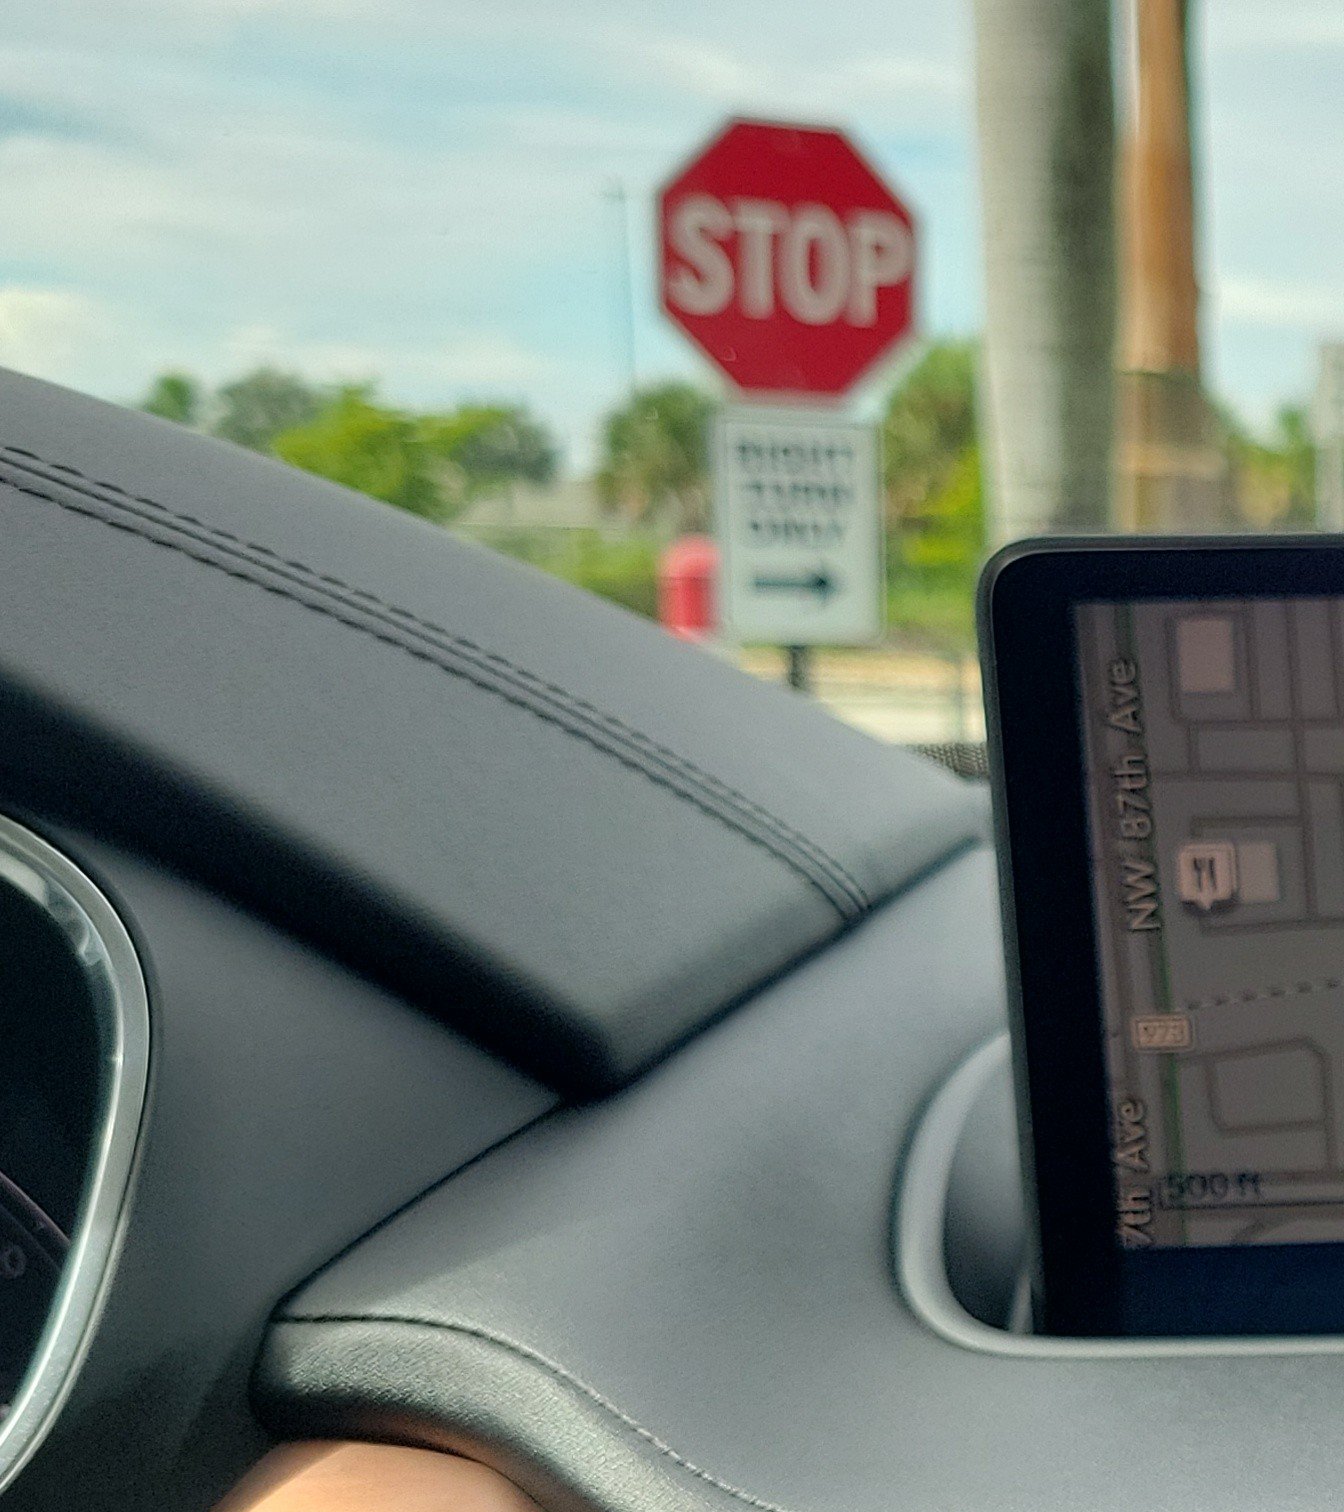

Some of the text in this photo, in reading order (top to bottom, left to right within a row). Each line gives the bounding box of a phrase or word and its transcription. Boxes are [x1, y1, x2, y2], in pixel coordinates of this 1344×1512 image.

[667, 195, 912, 327] STOP
[1109, 659, 1160, 933] NW 87th Ave
[1116, 1098, 1149, 1173] Ave
